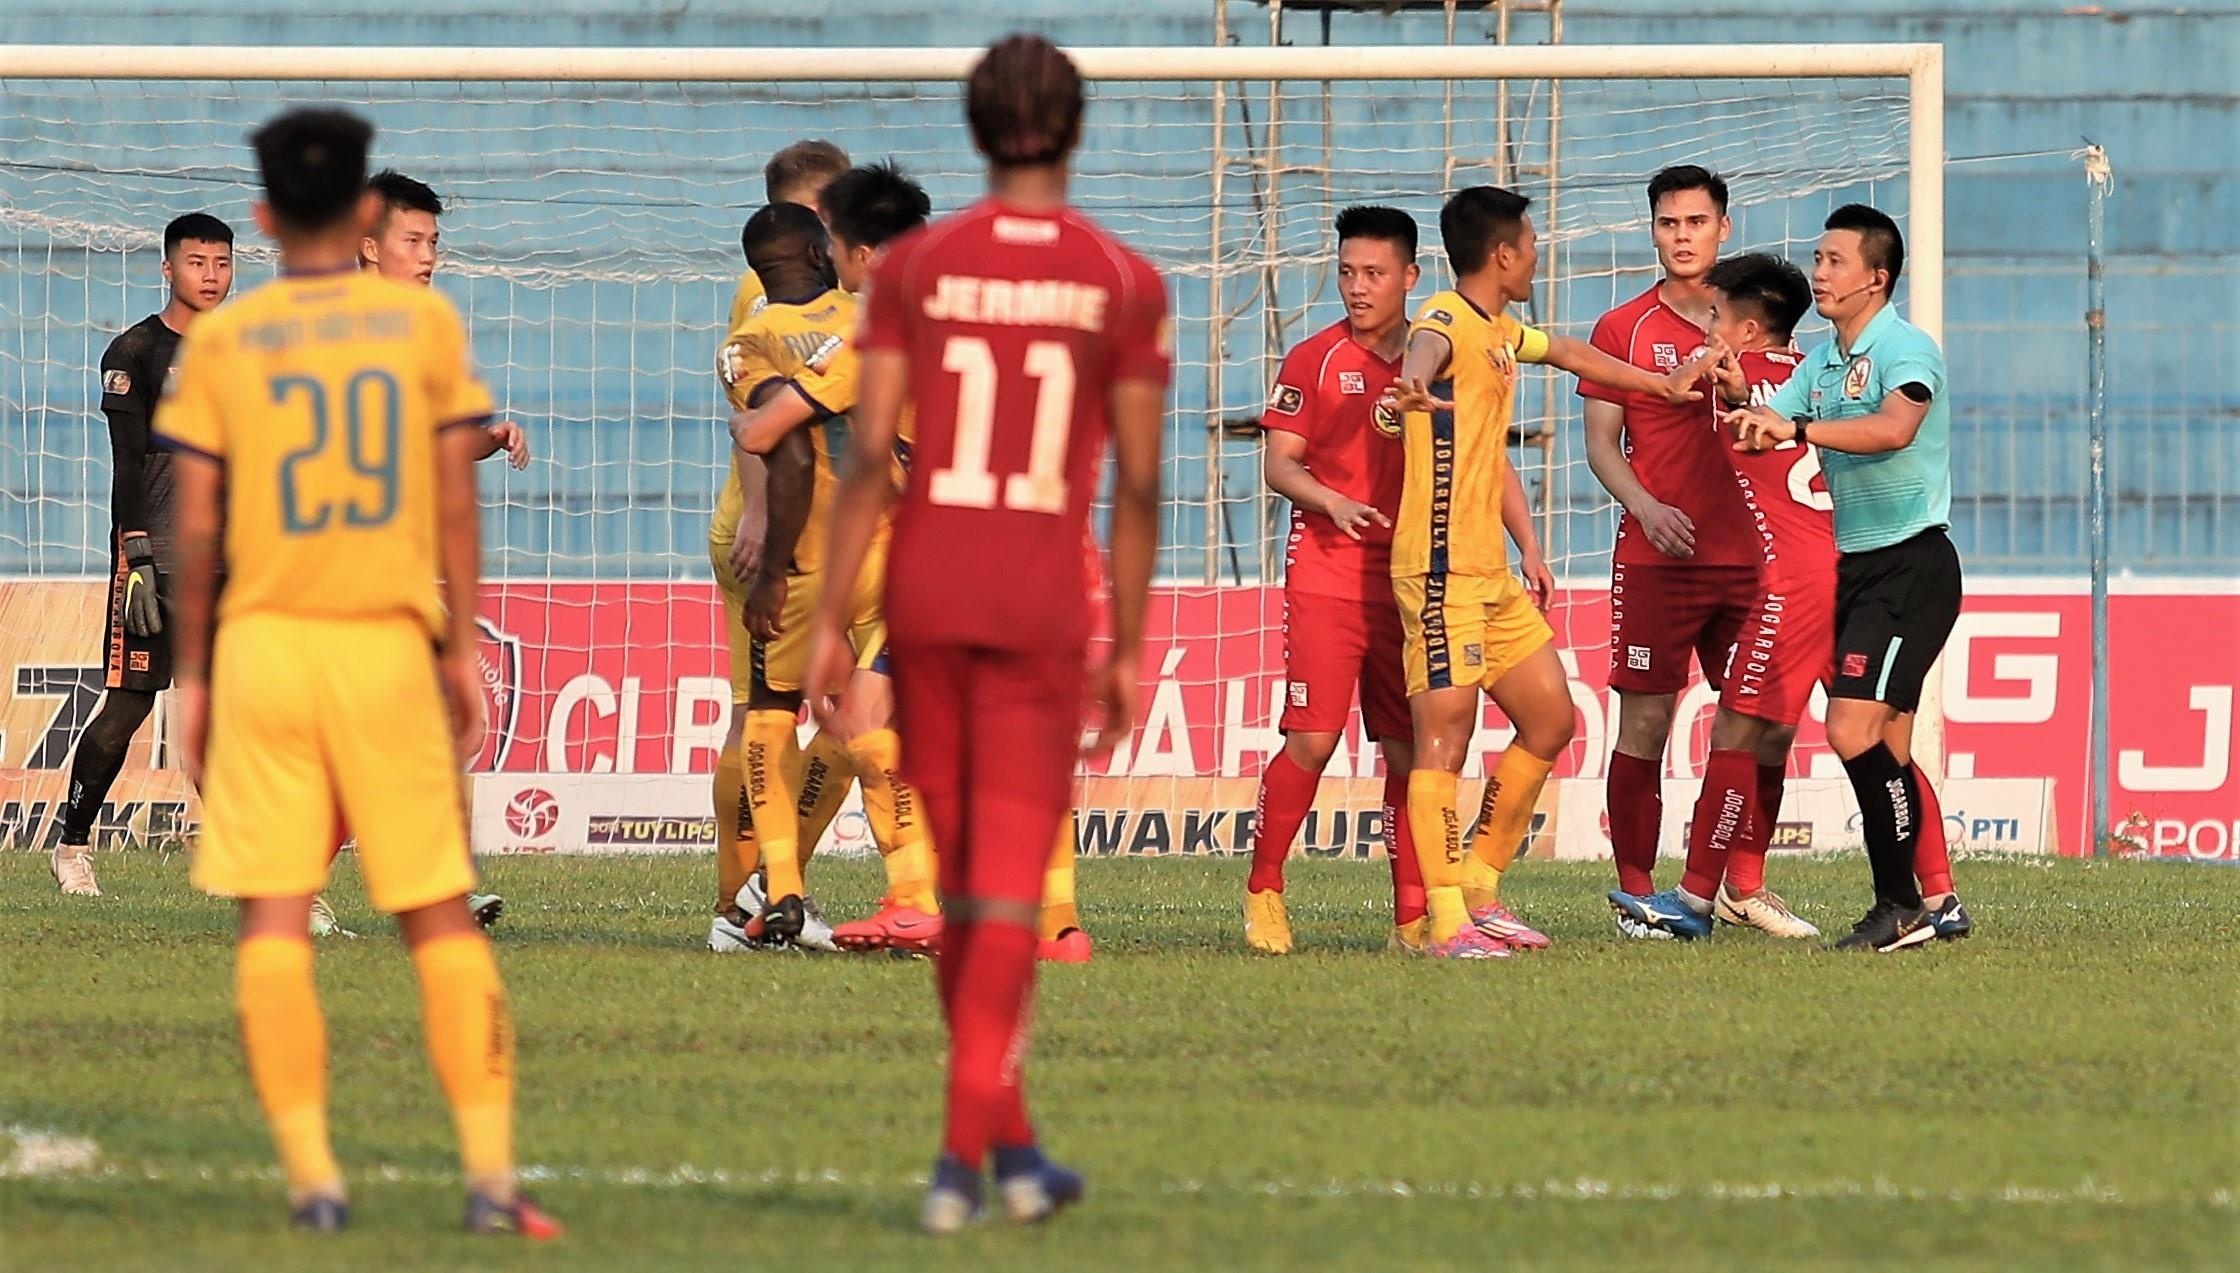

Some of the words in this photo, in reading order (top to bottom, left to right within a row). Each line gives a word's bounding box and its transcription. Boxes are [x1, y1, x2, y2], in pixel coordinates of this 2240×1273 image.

[269, 367, 402, 534] 29
[929, 336, 1077, 514] 11
[1739, 592, 1786, 696] JOGARBOLA
[620, 820, 716, 840] TUYLIPS
[1708, 788, 1745, 851] JOGARBOLA
[1885, 777, 1911, 842] JOGARBOLA
[1971, 818, 2019, 841] PTI
